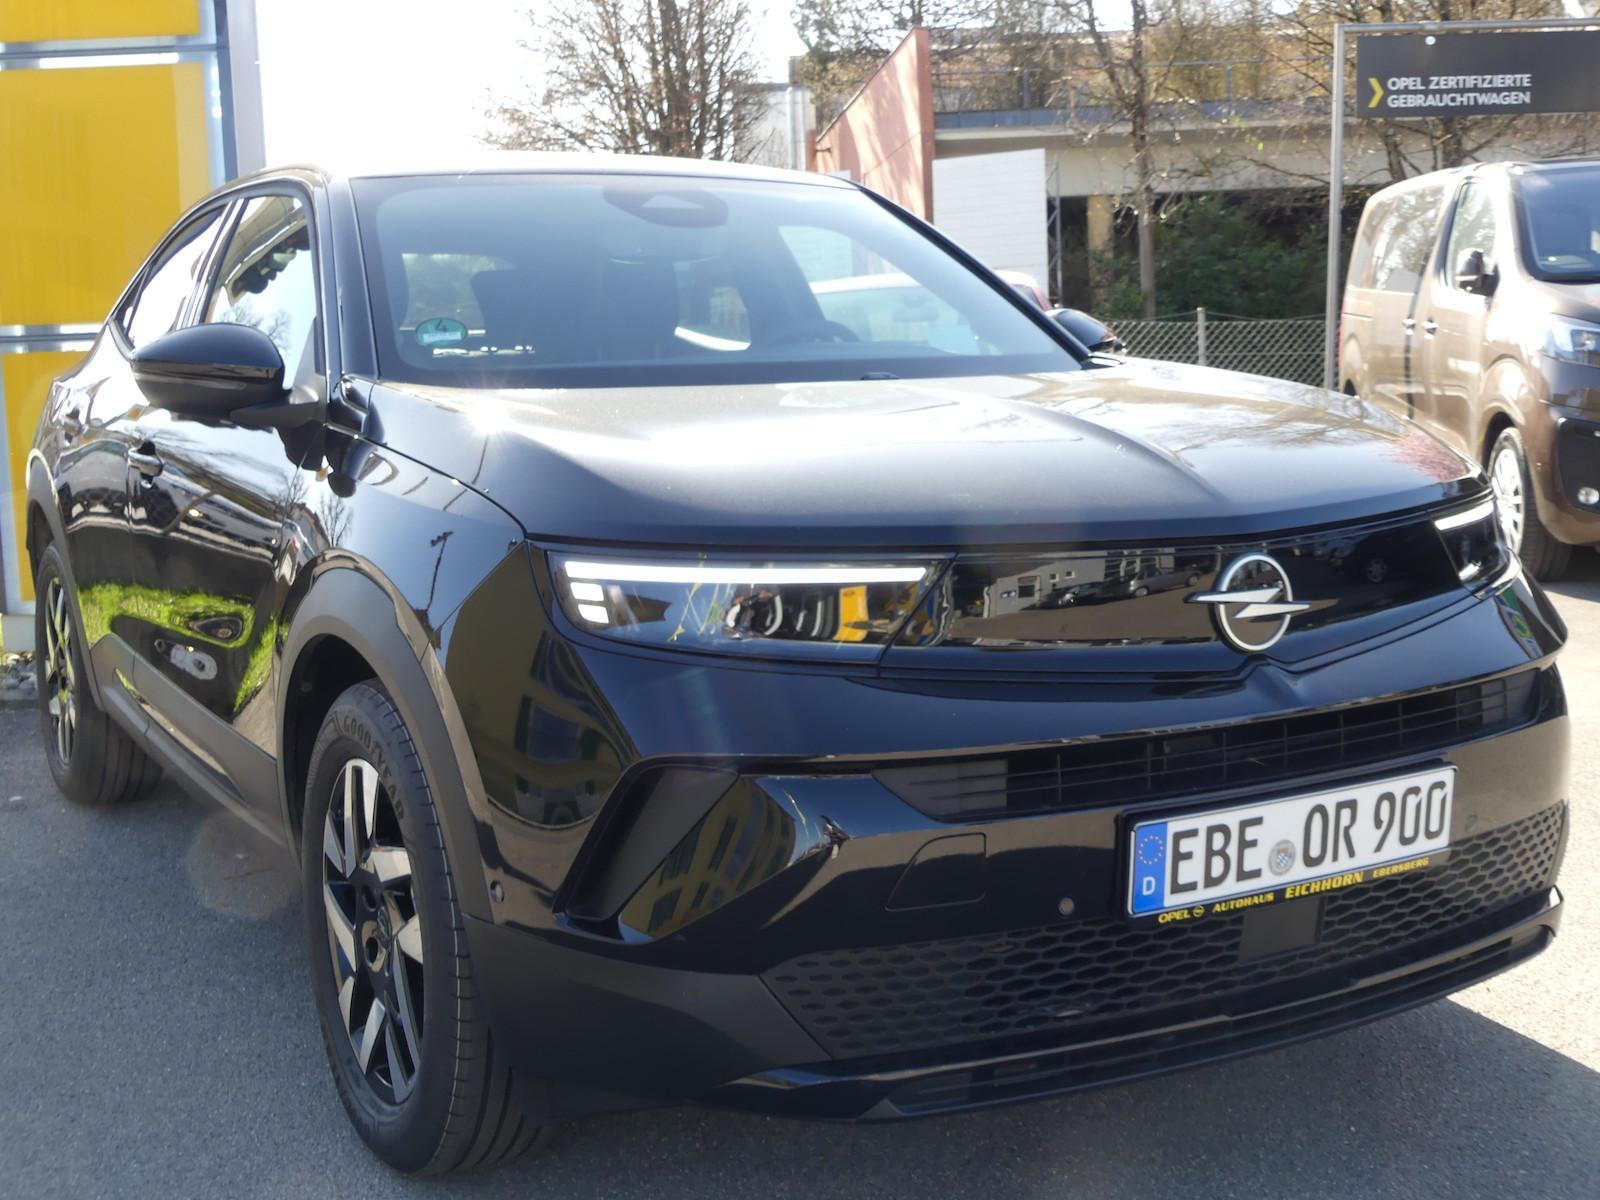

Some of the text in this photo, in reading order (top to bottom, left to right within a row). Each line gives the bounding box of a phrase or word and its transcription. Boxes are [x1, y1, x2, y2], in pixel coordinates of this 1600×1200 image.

[1387, 74, 1532, 90] OPEL ZERTIFIZIERTE
[1387, 91, 1531, 108] GEBRAUCHTWAGEN
[434, 319, 449, 333] 4
[343, 714, 405, 820] GOODYEAR
[1170, 816, 1264, 895] EBE
[1302, 798, 1358, 867] OR
[1373, 780, 1447, 853] 900
[1142, 876, 1156, 896] D
[1158, 857, 1430, 924] OPEL AUTOHAUS EICHHORN EBERSBERG
